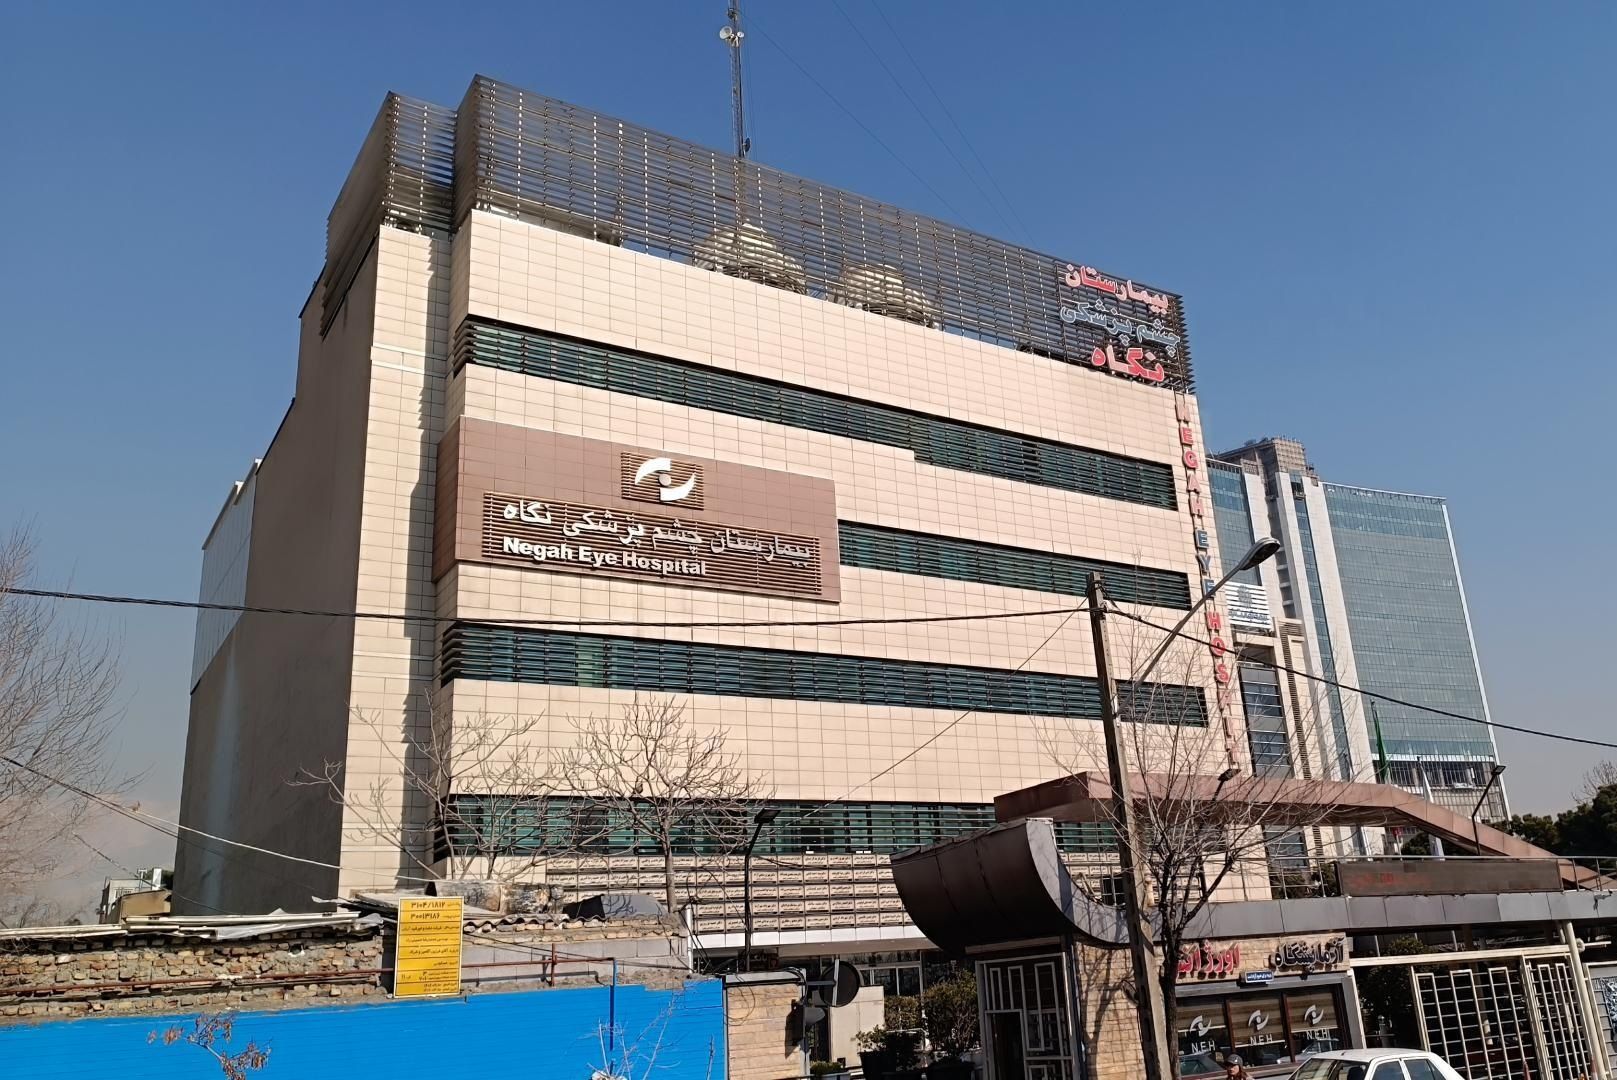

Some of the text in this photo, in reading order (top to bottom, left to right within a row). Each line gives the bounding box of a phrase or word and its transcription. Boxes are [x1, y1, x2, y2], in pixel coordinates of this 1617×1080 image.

[1065, 263, 1169, 314] بیمارستان
[1060, 298, 1181, 357] چشم پزشکی
[1091, 344, 1165, 383] نگاه
[1176, 403, 1205, 517] NEGAH
[1195, 529, 1216, 597] EYE
[503, 499, 811, 568] بیمارستان چشم پزشکی نگاه
[503, 536, 706, 576] Negah Eye Hospital
[1178, 939, 1241, 973] اورژان
[1274, 937, 1345, 972] آزمایشگاه
